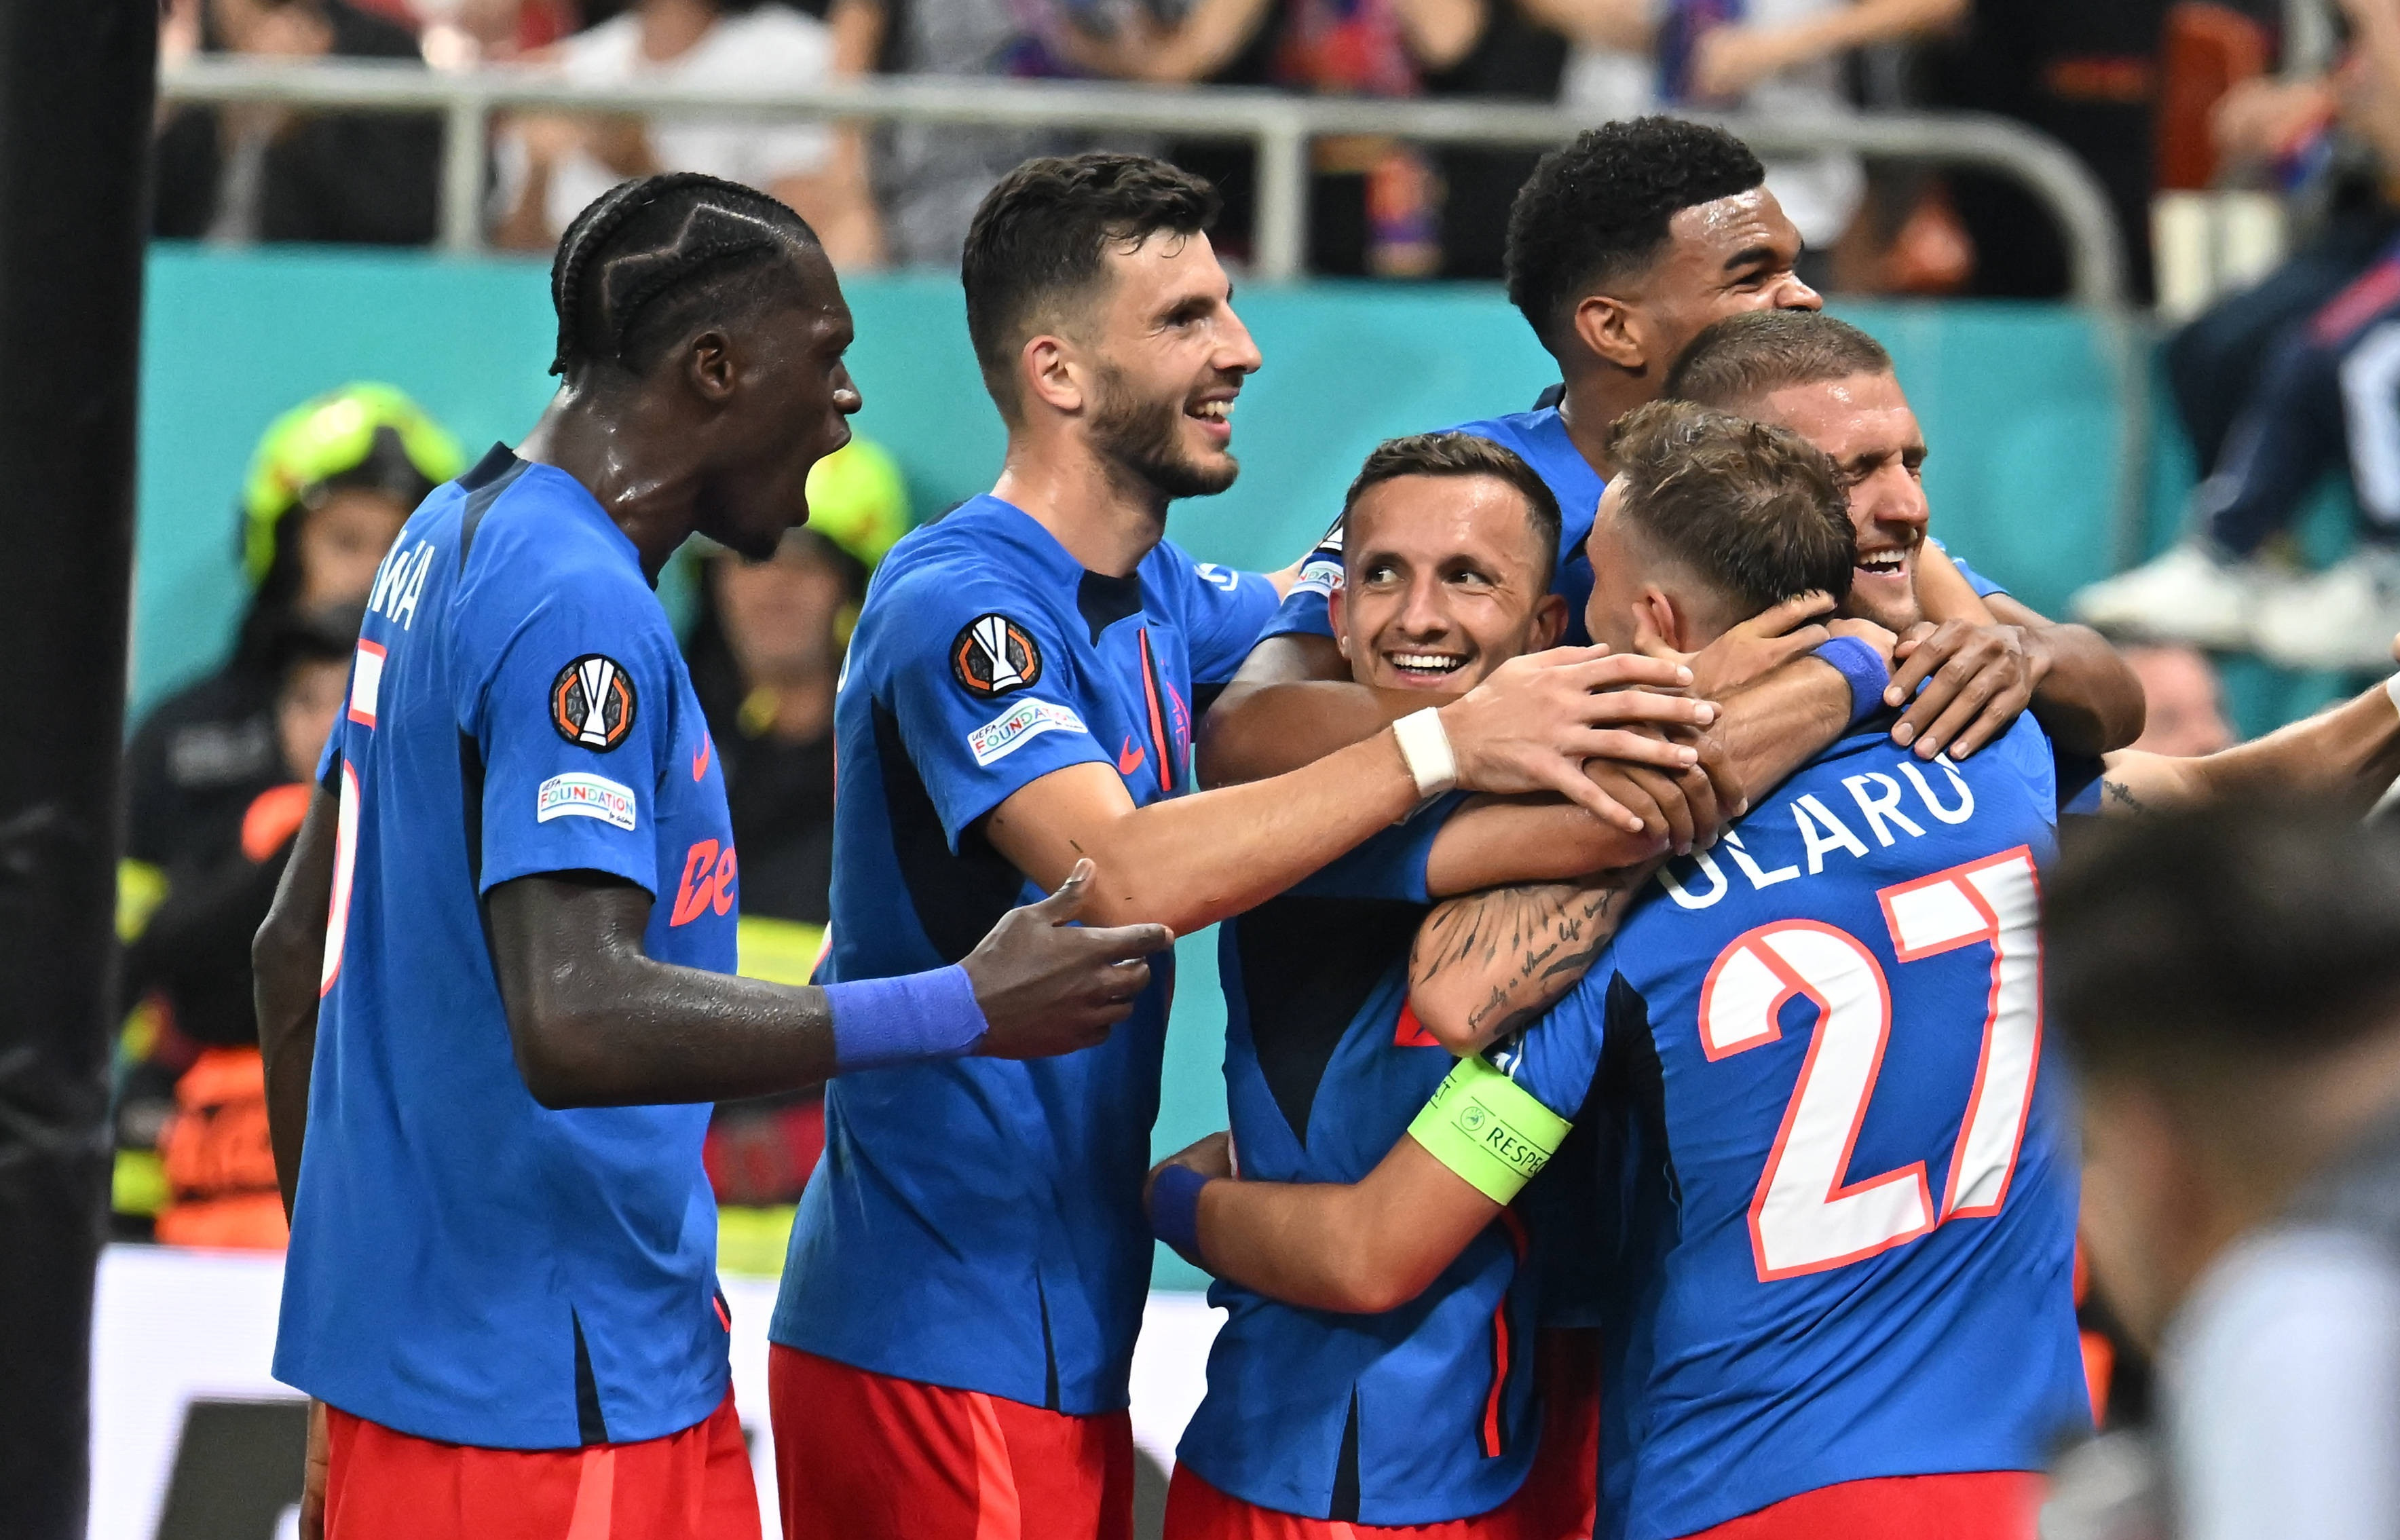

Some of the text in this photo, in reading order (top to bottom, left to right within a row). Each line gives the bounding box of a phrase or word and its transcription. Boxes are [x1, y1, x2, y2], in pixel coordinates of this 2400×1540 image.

[367, 530, 435, 631] WA
[972, 724, 997, 741] UEFA
[541, 786, 633, 815] FOUNDATION
[1698, 844, 2044, 1283] 27
